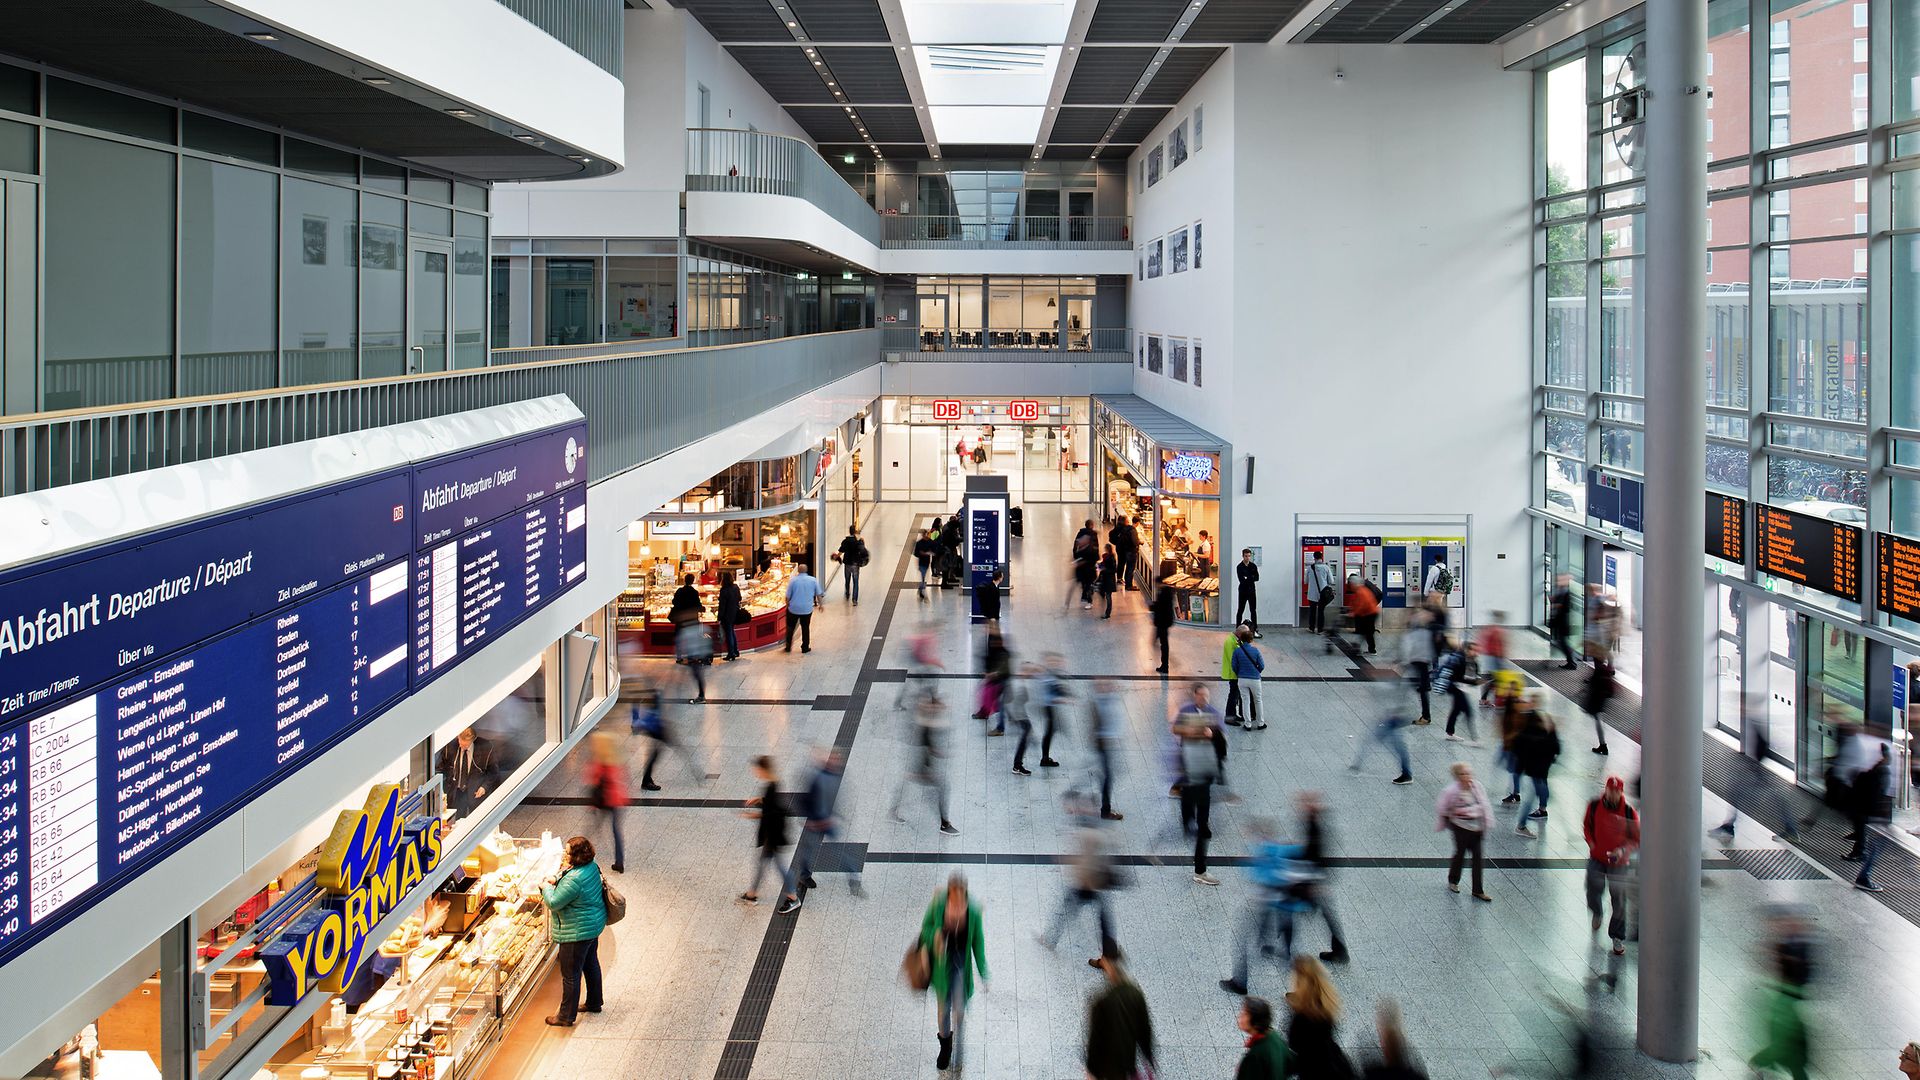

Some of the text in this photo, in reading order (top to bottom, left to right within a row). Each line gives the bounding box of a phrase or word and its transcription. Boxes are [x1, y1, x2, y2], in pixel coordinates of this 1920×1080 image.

[937, 403, 958, 417] DB
[1014, 403, 1036, 417] DB
[422, 481, 458, 512] Abfahrt
[460, 475, 492, 499] Departure
[496, 466, 517, 487] Départ
[394, 507, 404, 520] DB
[344, 562, 358, 576] Gleis
[278, 580, 318, 602] Ziel Destination
[0, 593, 100, 658] Abfahrt
[108, 575, 191, 621] Departure
[205, 551, 252, 587] Départ
[278, 615, 298, 630] Rheine
[278, 631, 298, 647] Emden
[118, 645, 155, 667] Über Via
[277, 640, 309, 663] Osnabrück
[118, 680, 147, 699] Greven
[154, 660, 193, 683] Emsdetten
[278, 657, 305, 680] Dortmund
[1, 675, 80, 715] Zeit Time/Temps
[278, 677, 298, 697] Krefeld
[118, 700, 146, 720] Rheine
[153, 683, 183, 704] Meppen
[277, 695, 328, 731] Mönchengladbach
[278, 696, 298, 714] Rheine
[31, 717, 55, 736] RE 7
[118, 699, 186, 741] Lengerich (Westf)
[118, 741, 145, 761] Werne
[147, 735, 154, 748] (a
[156, 729, 161, 741] d
[164, 721, 184, 738] Lippe
[191, 707, 211, 724] Lünen
[212, 697, 225, 712] Hbf
[32, 734, 69, 759] IC 2004
[278, 728, 299, 747] Gronau
[118, 761, 144, 782] Hamm
[151, 745, 176, 764] Hagen
[183, 732, 198, 747] Köln
[278, 740, 303, 764] Coesfeld
[32, 759, 62, 782] RB 66
[118, 729, 237, 803] MS-Sprakel Greven Emsdetten
[33, 781, 62, 804] RB 50
[119, 763, 210, 823] Dülmen Haltern am See
[33, 806, 56, 828] RE 7
[119, 786, 202, 843] MS-Häger Nordwalde
[33, 826, 62, 850] RB 65
[119, 804, 200, 864] Havixbeck Billerbeck
[33, 848, 63, 872] RE 42
[299, 859, 319, 869] Kaff
[33, 869, 62, 894] RB 64
[34, 891, 63, 917] RB 63
[286, 817, 442, 1003] YORMA'S
